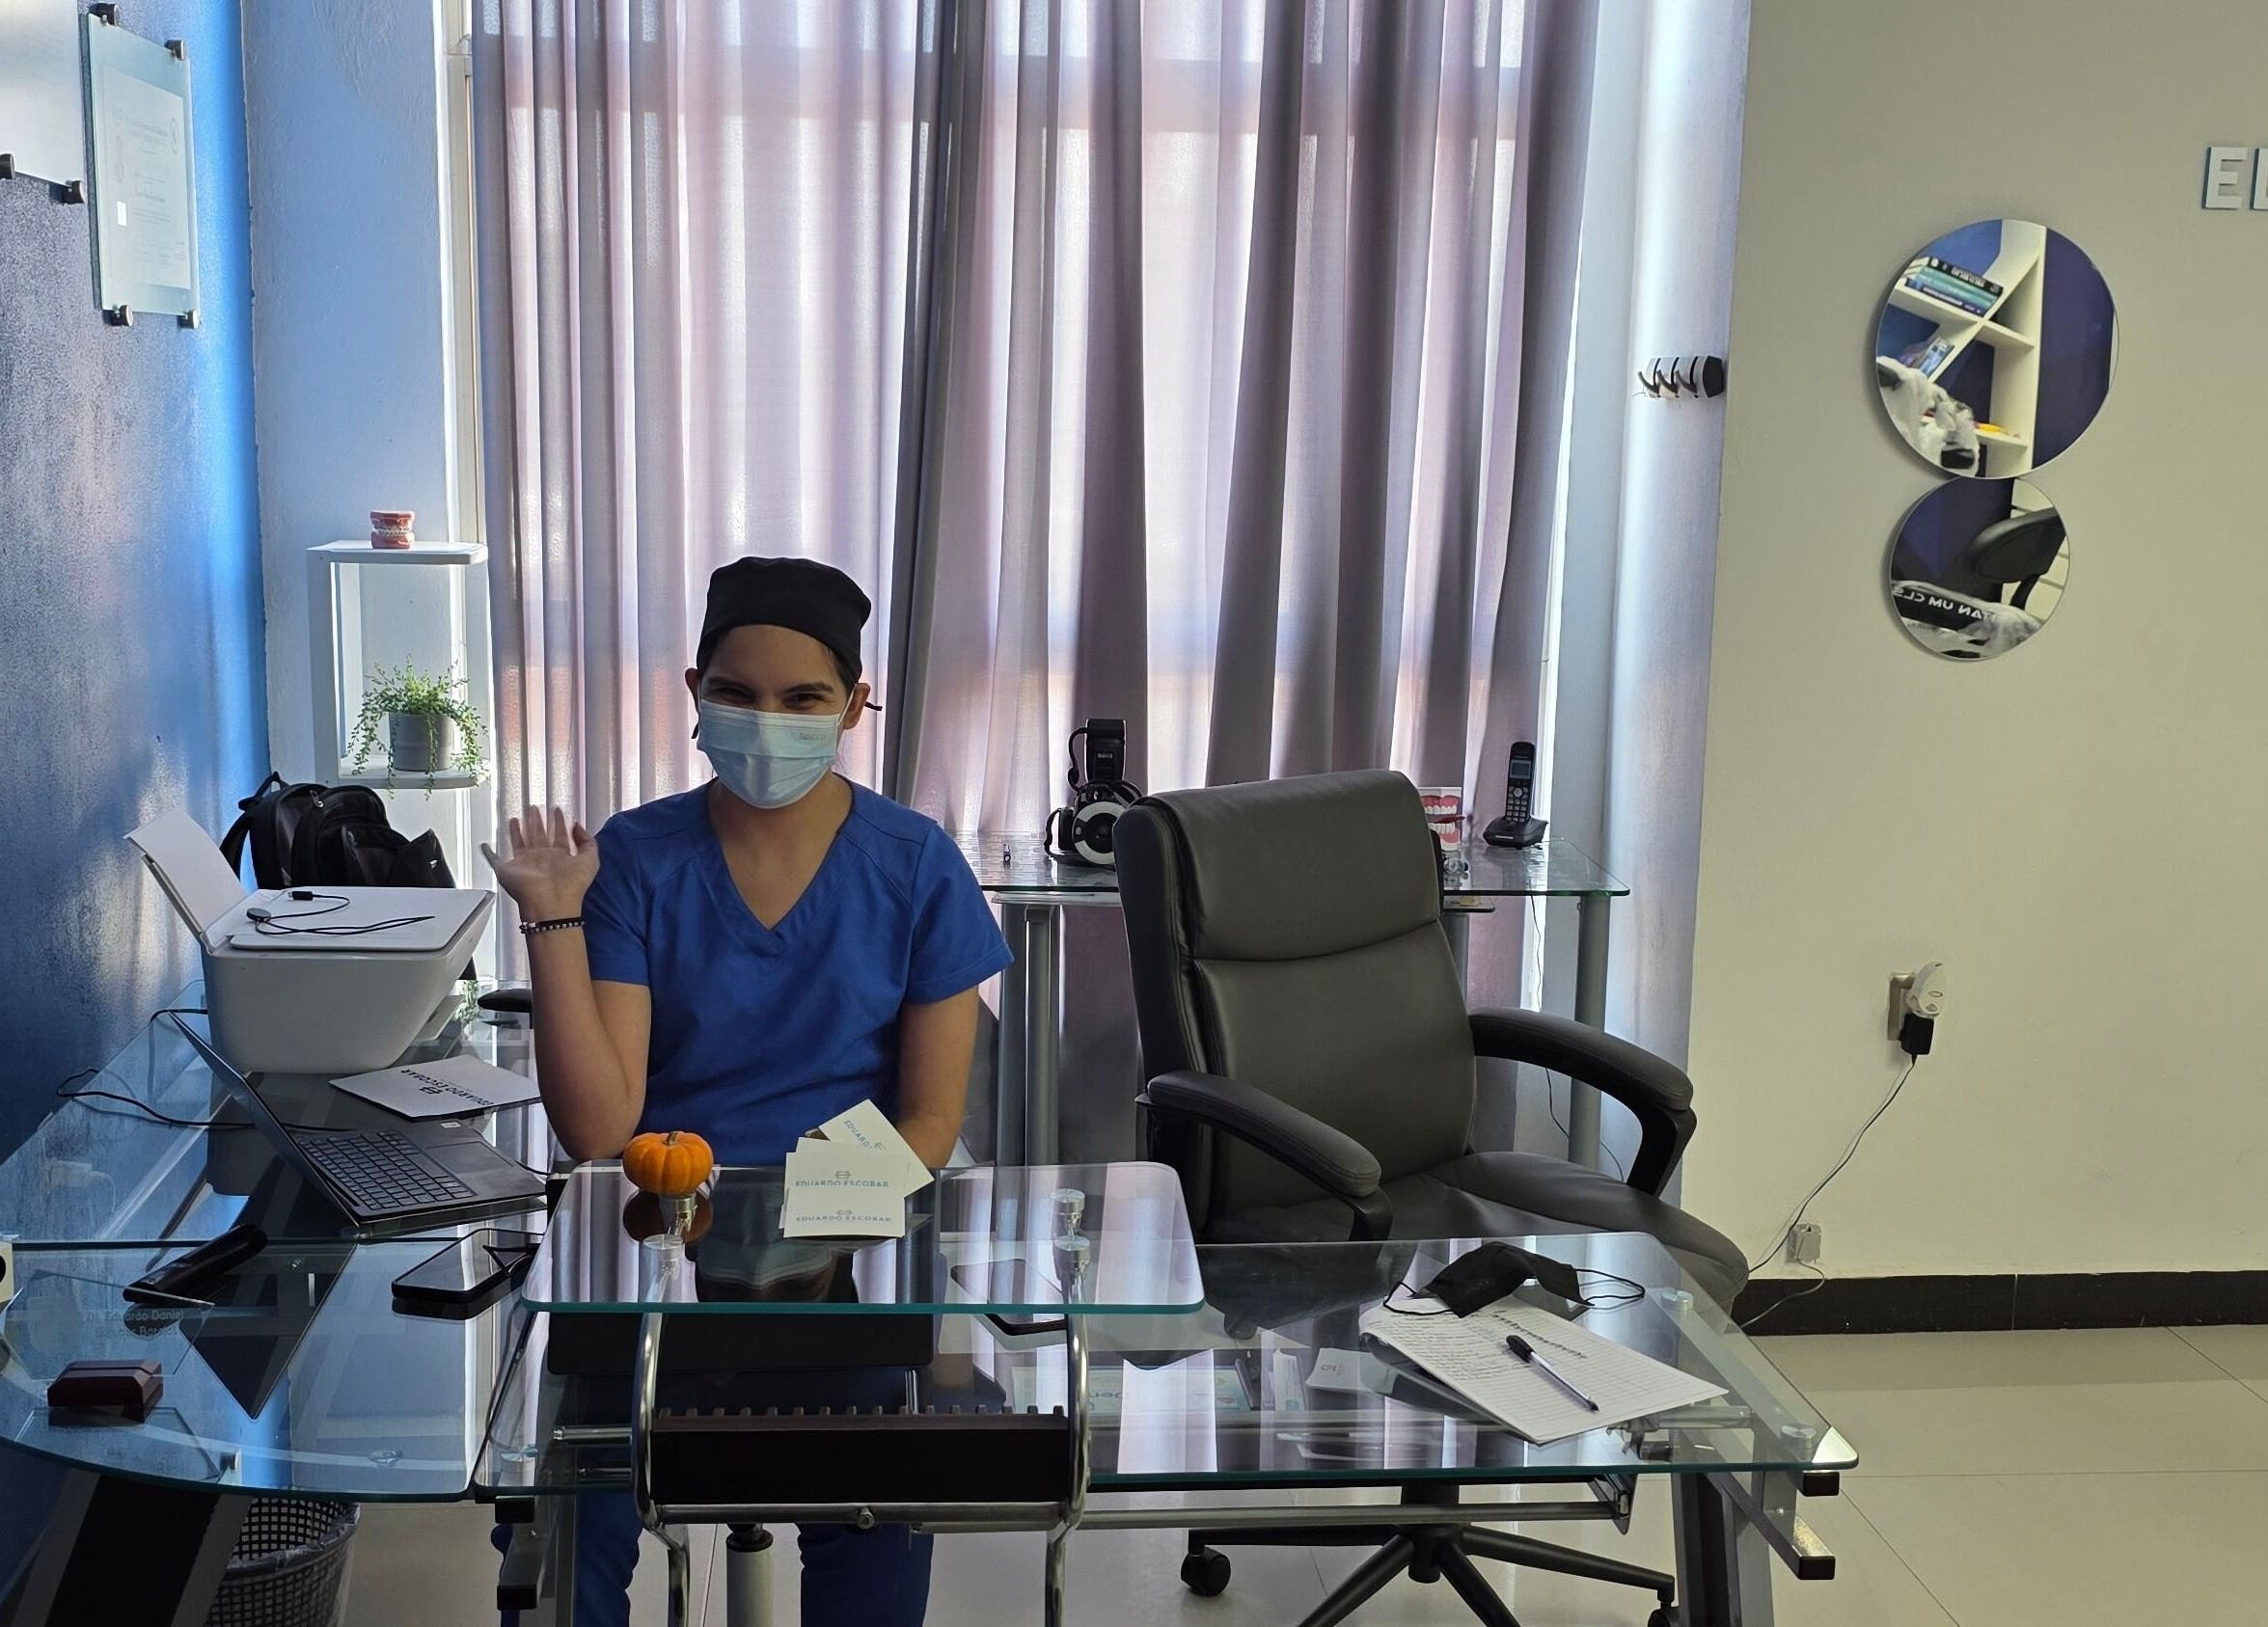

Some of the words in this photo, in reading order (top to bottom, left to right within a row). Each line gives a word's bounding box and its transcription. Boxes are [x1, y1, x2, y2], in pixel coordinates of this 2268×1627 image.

[844, 1120, 873, 1149] EDUARD
[795, 1180, 842, 1188] EDUARDO
[844, 1180, 889, 1188] ESCOBAR
